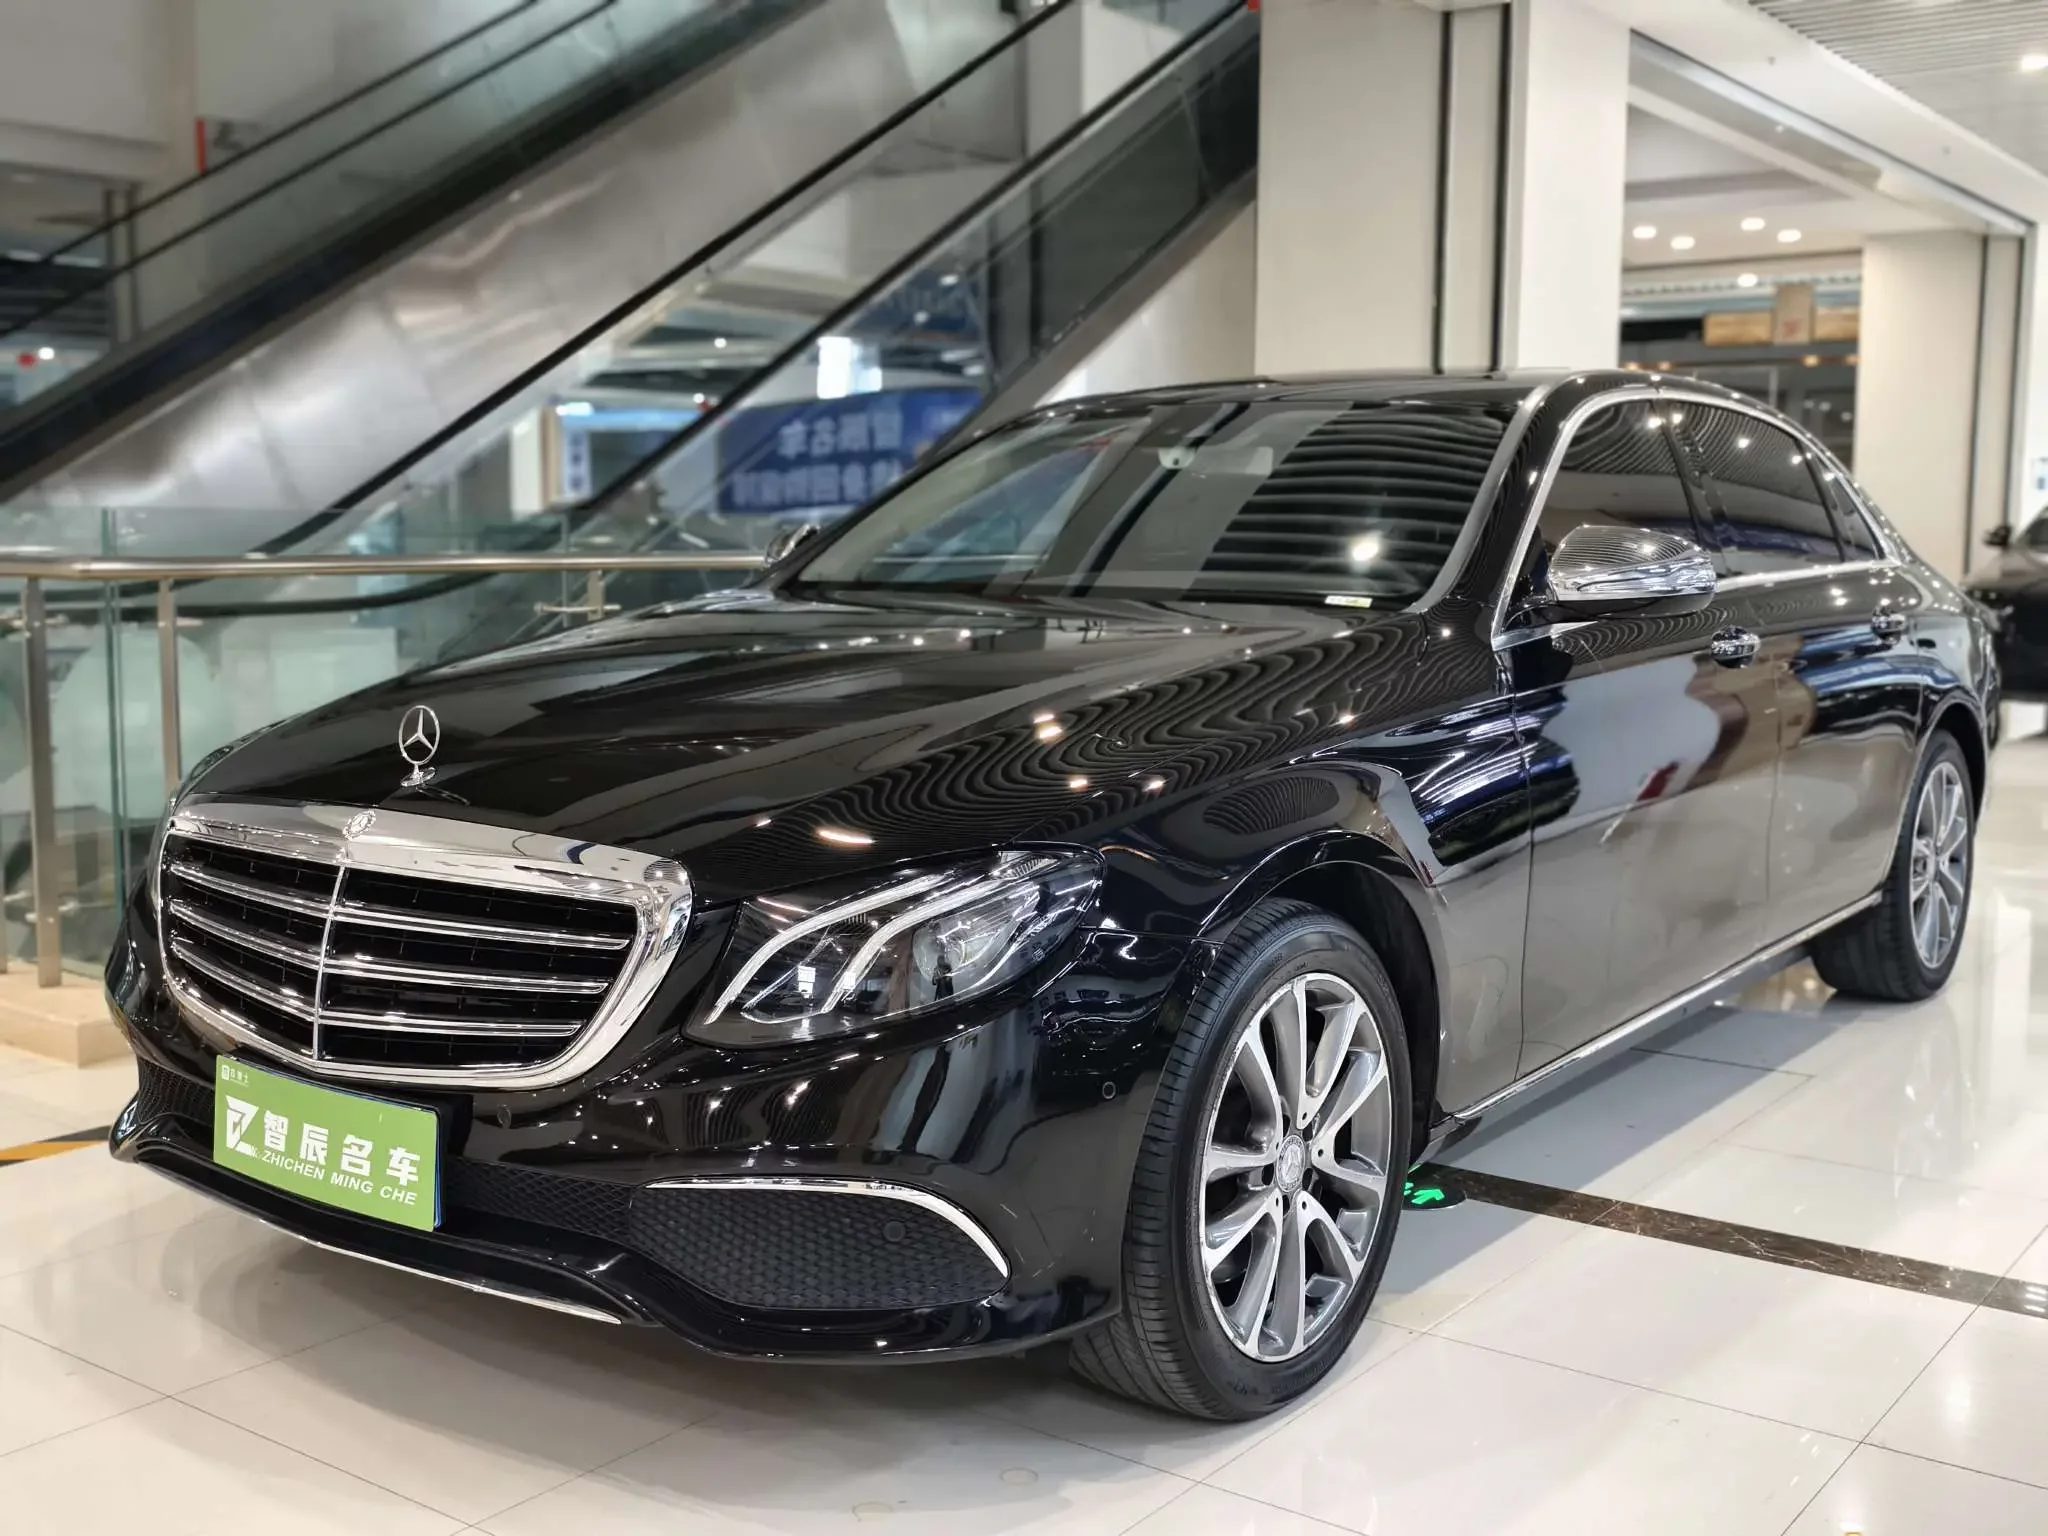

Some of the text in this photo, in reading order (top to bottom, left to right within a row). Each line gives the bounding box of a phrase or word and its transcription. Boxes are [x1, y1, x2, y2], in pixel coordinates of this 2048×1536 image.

[261, 1150, 418, 1206] ZHICHEN MING CHE
[264, 1110, 421, 1187] 智辰名车
